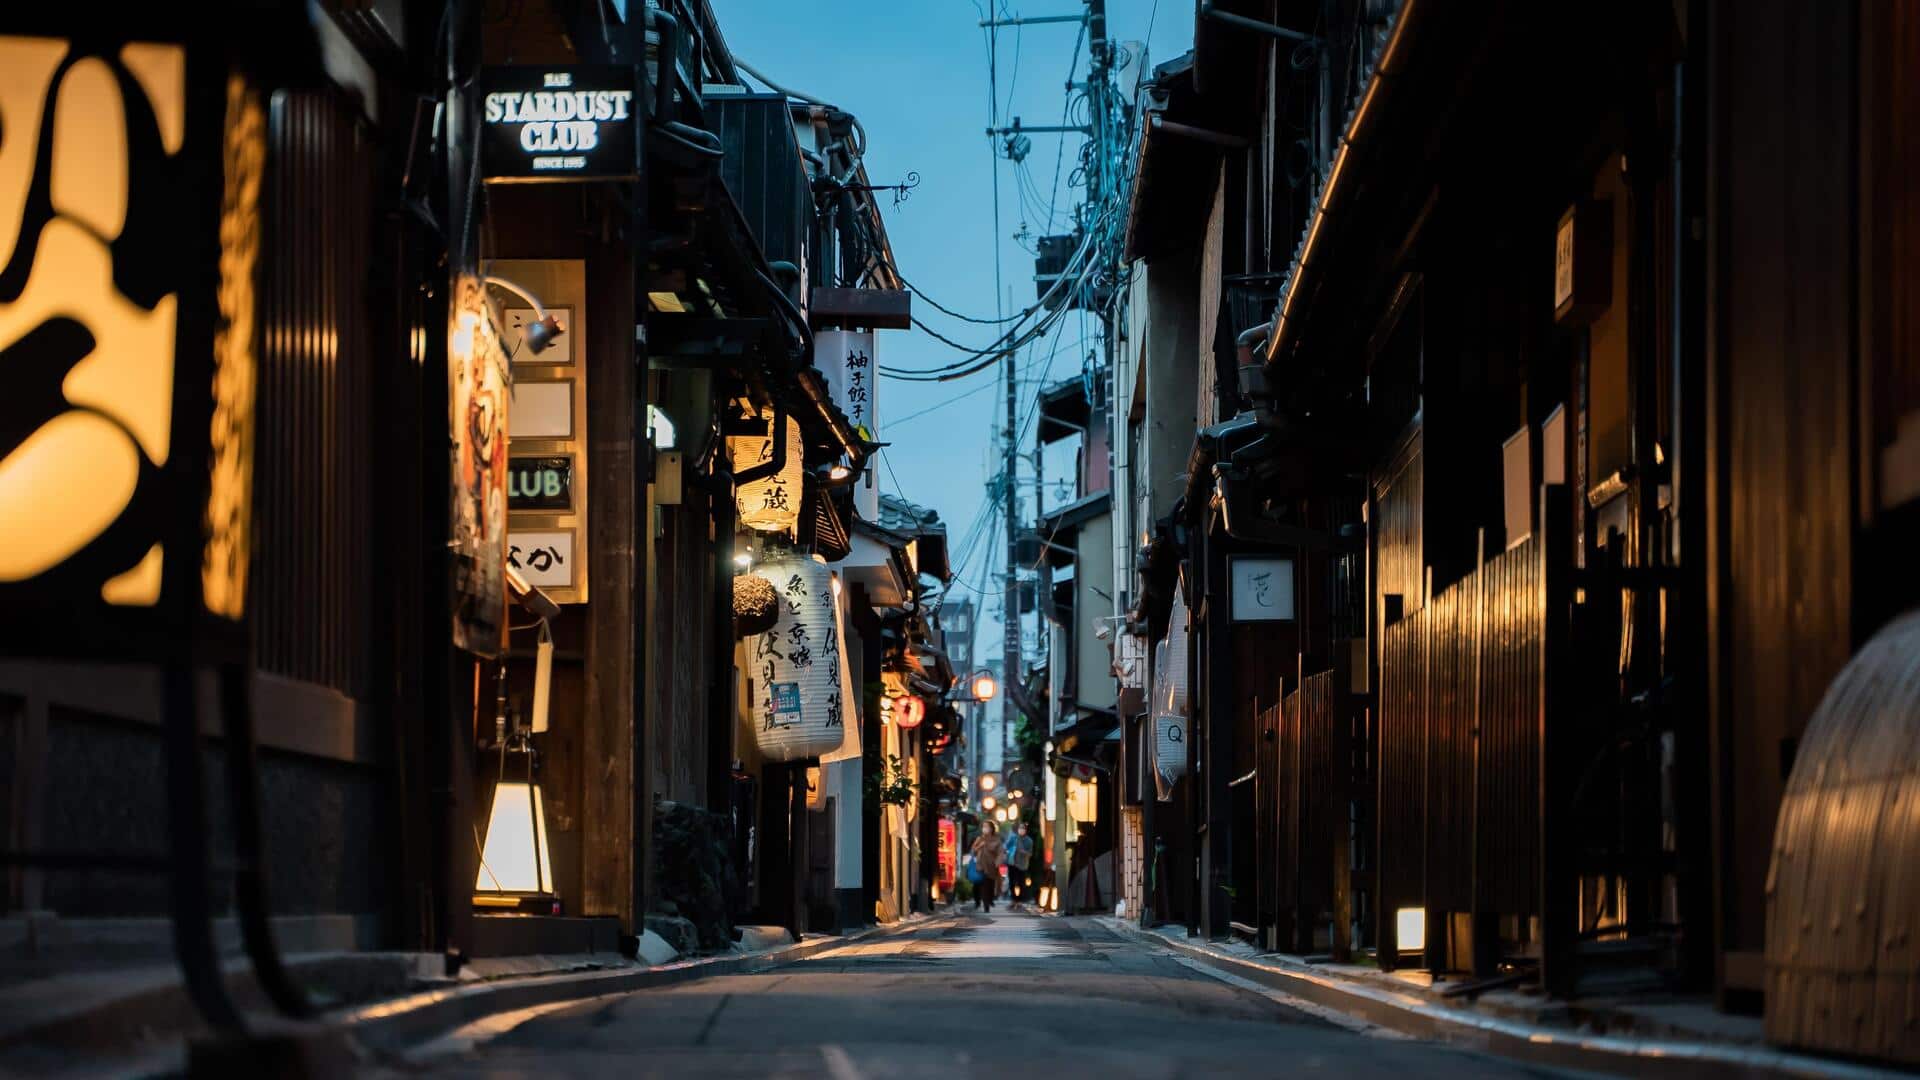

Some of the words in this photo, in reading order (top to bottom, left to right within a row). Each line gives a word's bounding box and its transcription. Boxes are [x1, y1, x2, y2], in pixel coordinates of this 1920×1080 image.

[485, 90, 632, 123] STARDUST
[520, 121, 599, 151] CLUB
[846, 349, 868, 419] 柚子餃子
